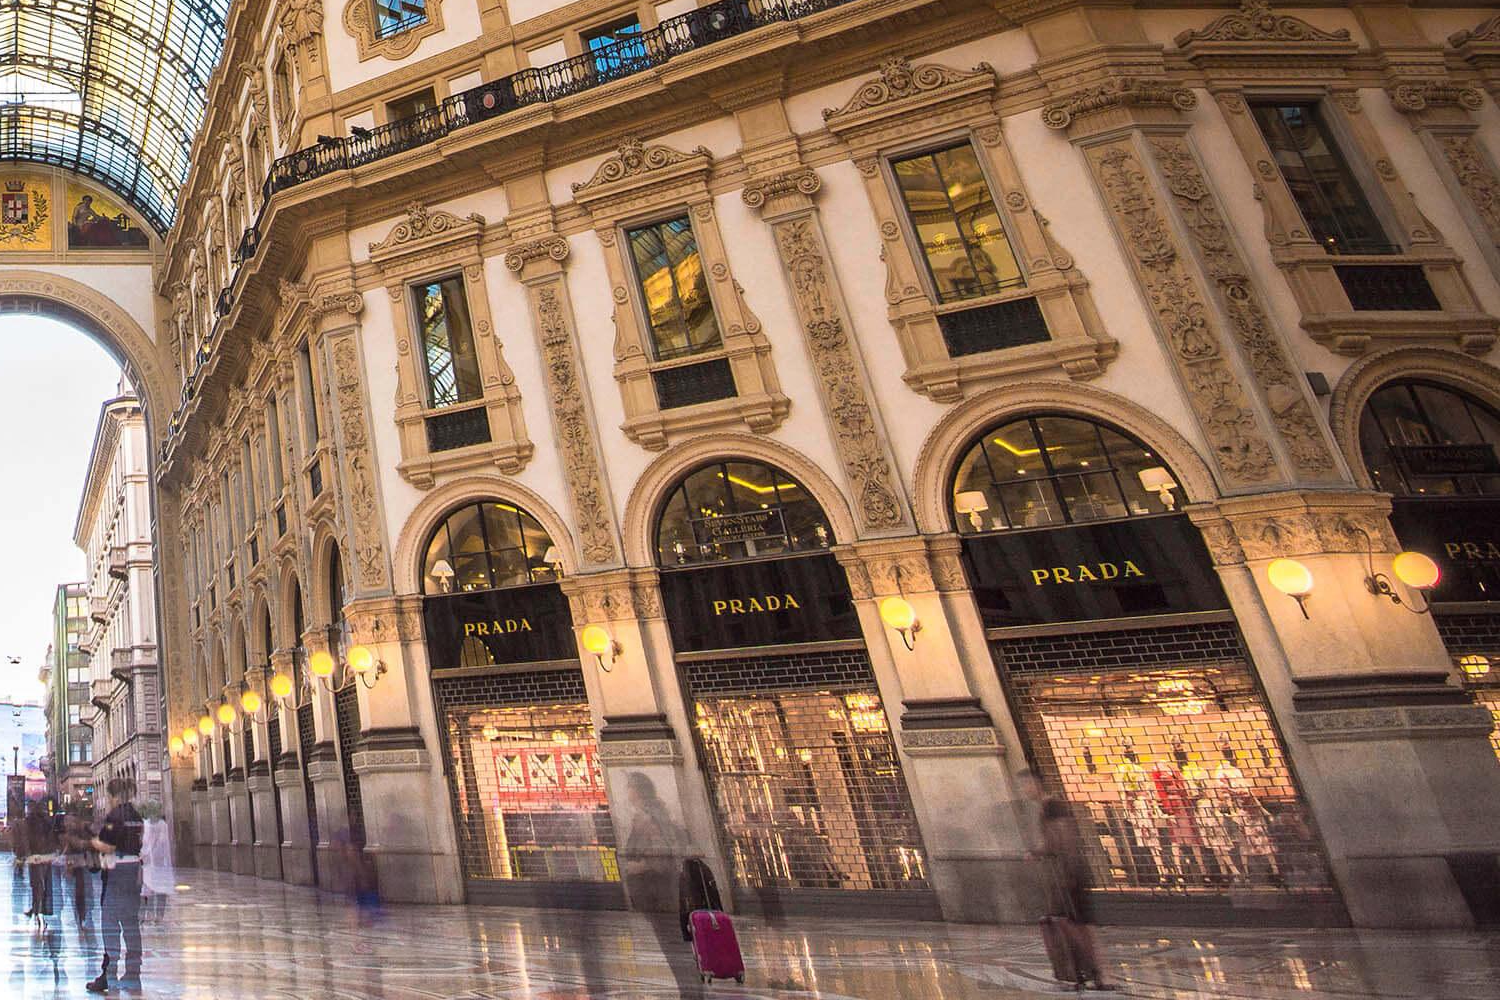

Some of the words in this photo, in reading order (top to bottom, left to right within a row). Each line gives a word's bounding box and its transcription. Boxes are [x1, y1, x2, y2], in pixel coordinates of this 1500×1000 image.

[1030, 560, 1145, 586] PRADA
[713, 594, 800, 616] PRADA
[464, 618, 532, 636] PRADA
